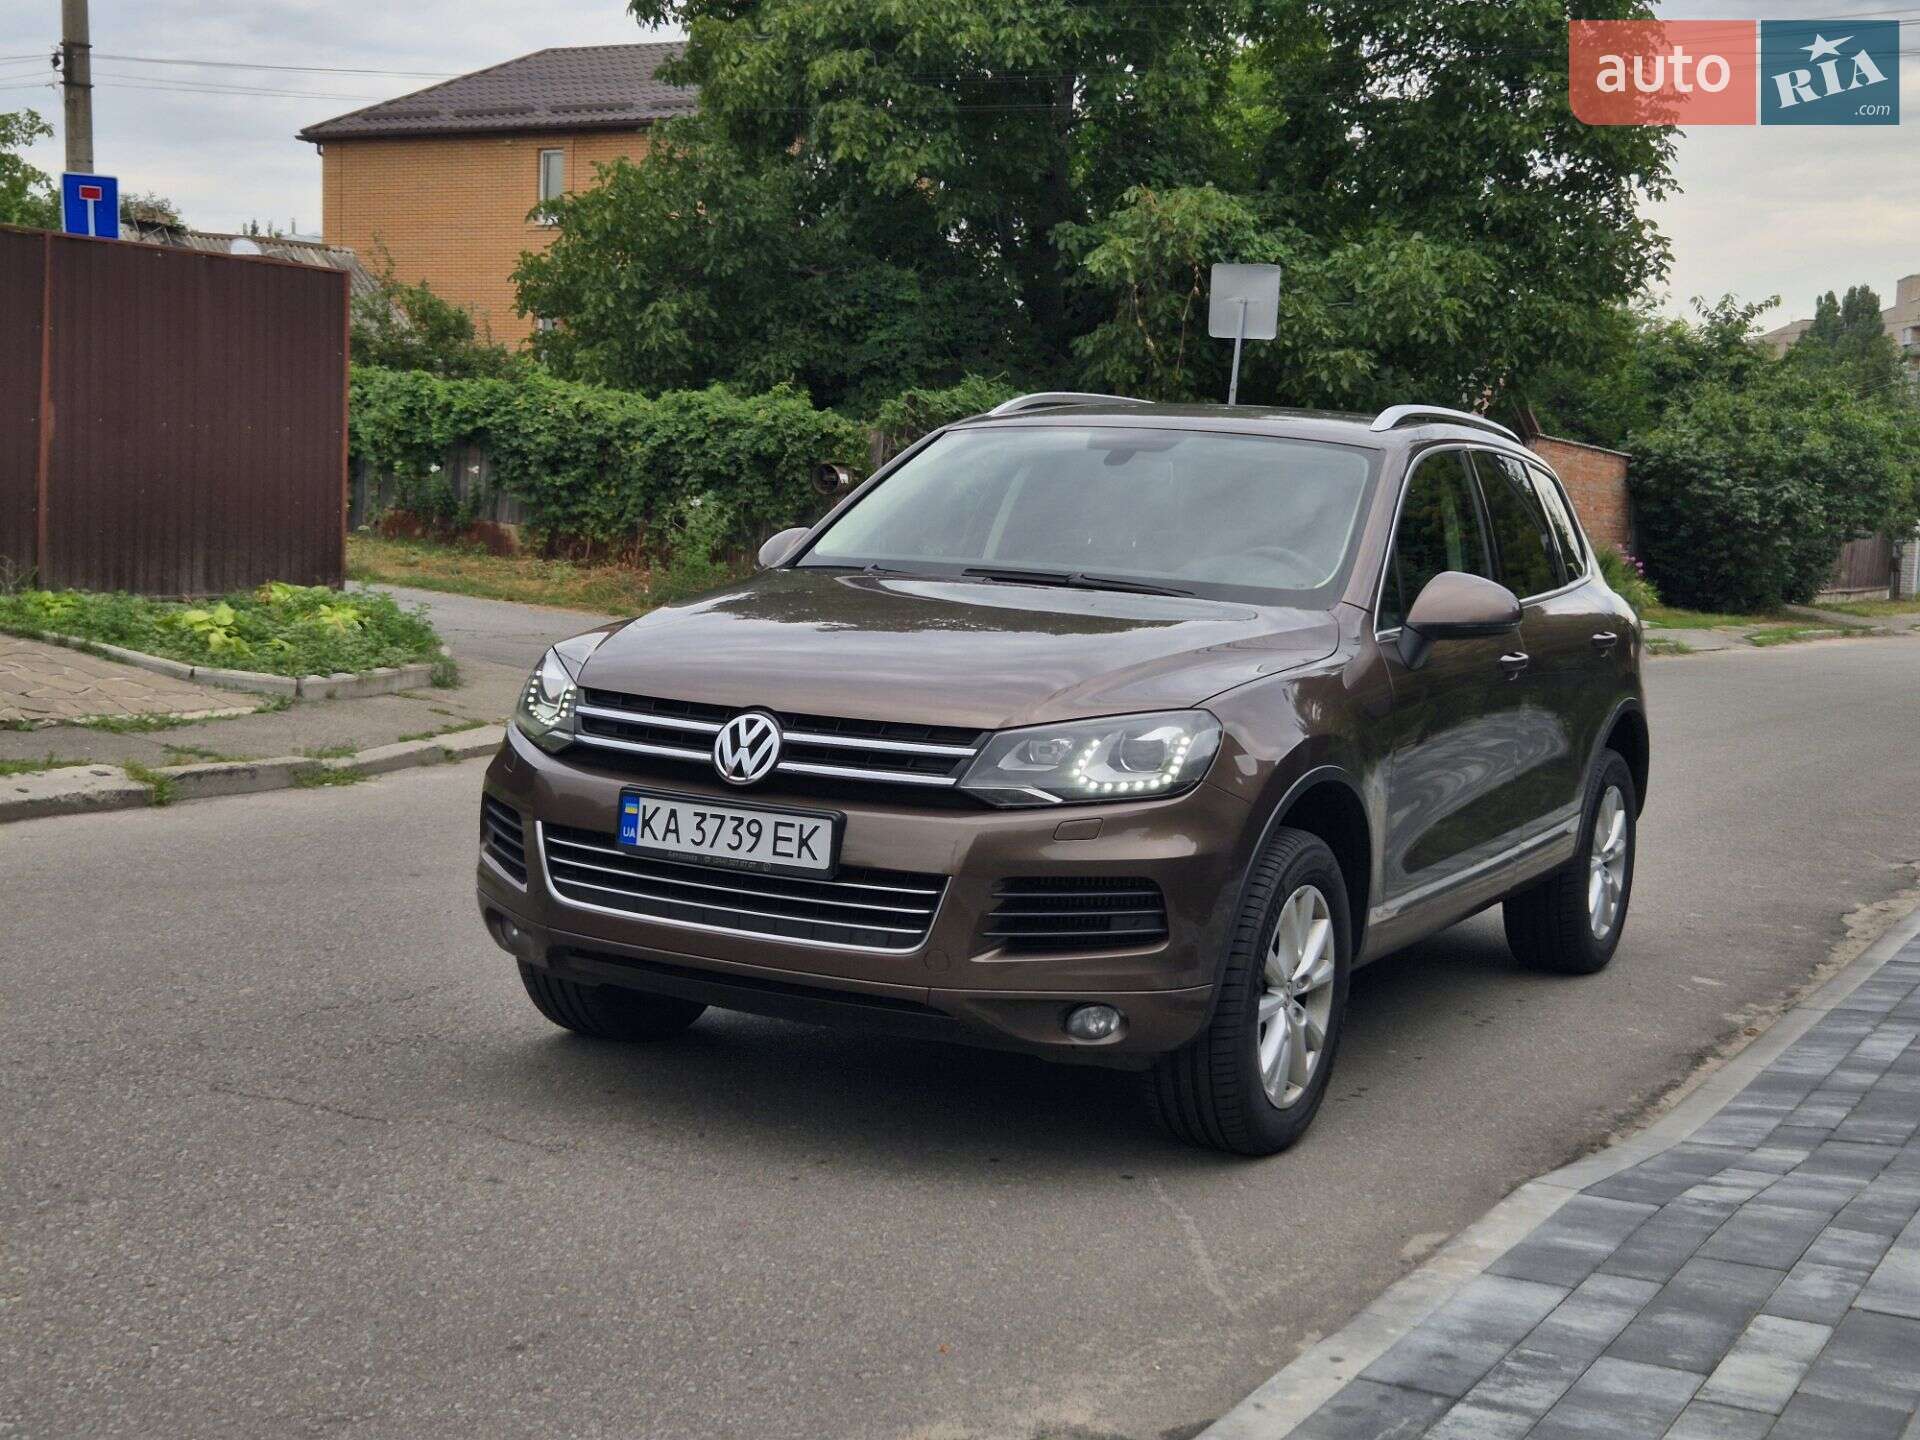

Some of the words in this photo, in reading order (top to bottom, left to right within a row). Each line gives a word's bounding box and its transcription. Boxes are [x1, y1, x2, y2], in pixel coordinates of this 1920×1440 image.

[622, 825, 636, 838] UA
[640, 804, 681, 843] KA
[690, 811, 763, 853] 3739
[772, 821, 820, 861] EK
